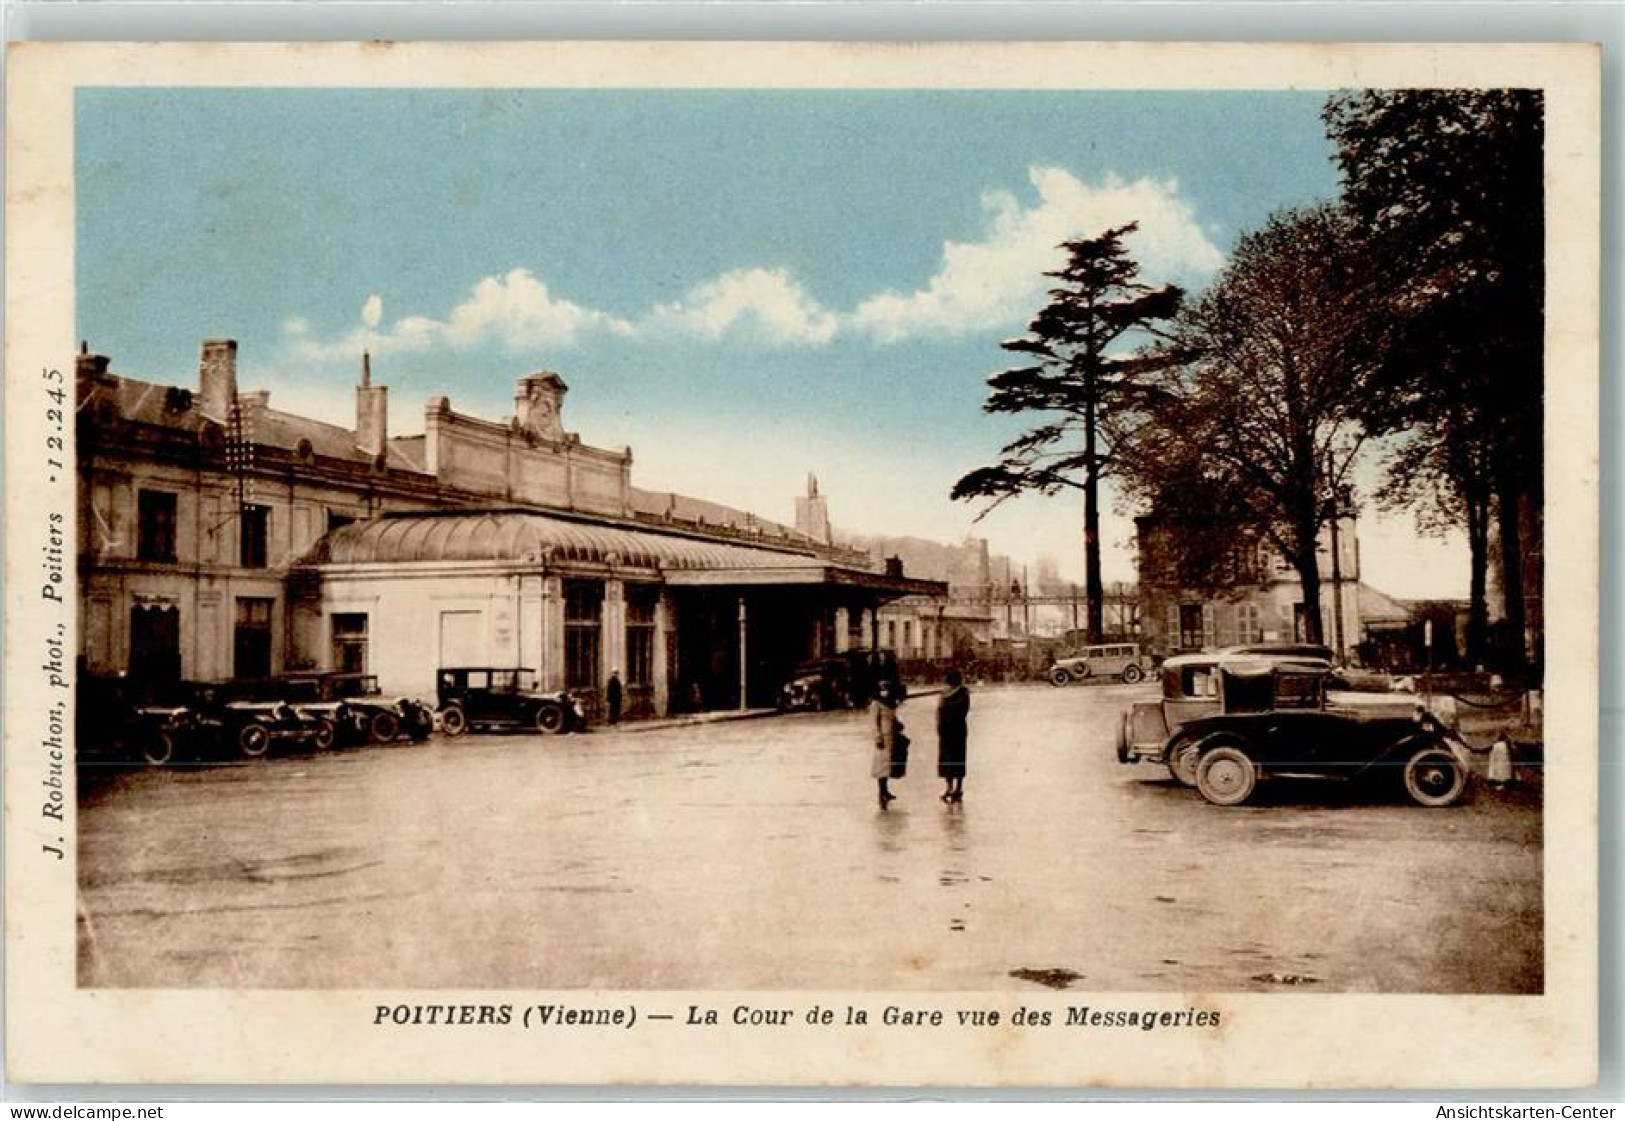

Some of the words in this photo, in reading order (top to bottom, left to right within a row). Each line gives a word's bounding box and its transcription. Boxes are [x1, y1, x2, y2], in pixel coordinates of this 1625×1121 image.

[42, 512, 63, 604] Poitiers
[42, 622, 70, 689] phot.,
[42, 700, 66, 823] Robuchon,
[42, 837, 64, 861] J.
[373, 1004, 513, 1025] POITIERS
[523, 1005, 637, 1030] (Vienne)
[685, 1005, 718, 1025] La
[733, 1005, 794, 1026] Cour
[805, 1005, 834, 1025] de
[845, 1006, 868, 1025] la
[883, 1006, 943, 1027] Gare
[956, 1010, 1001, 1027] vue
[1011, 1006, 1052, 1027] des
[1065, 1006, 1221, 1032] Messageries
